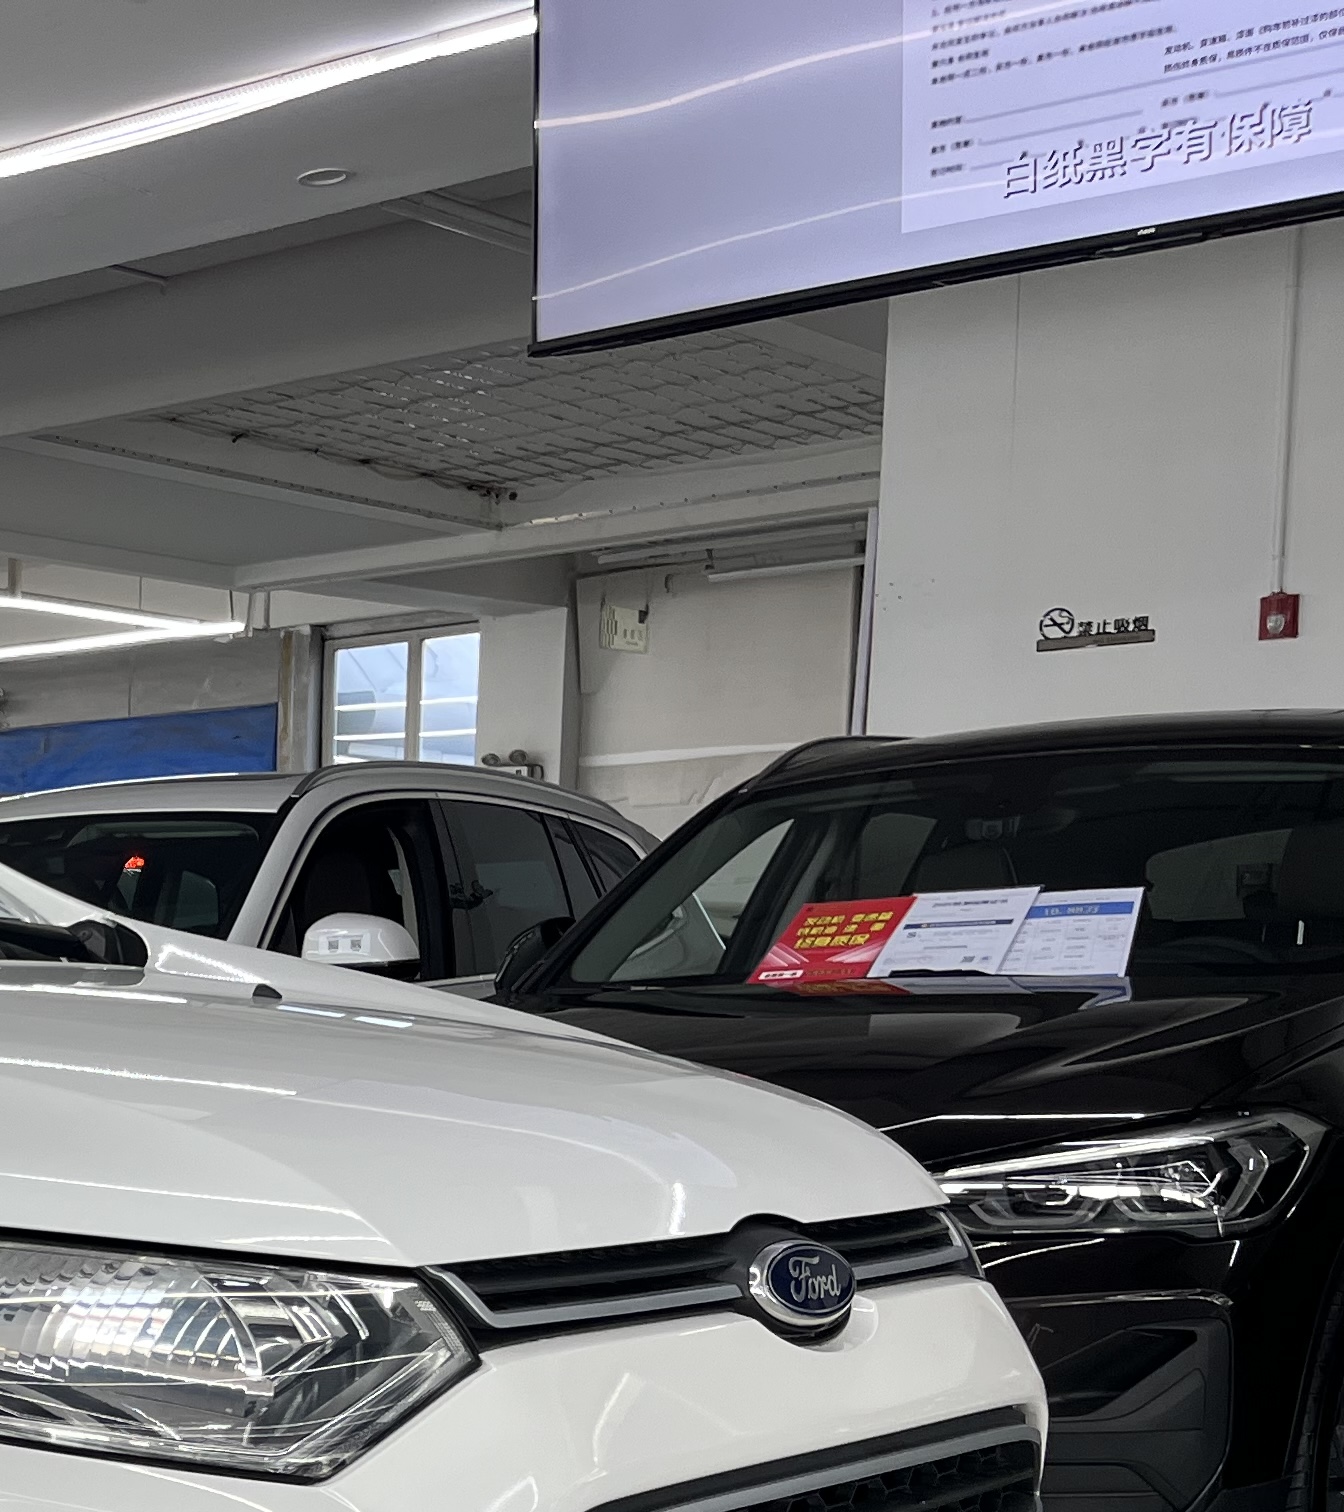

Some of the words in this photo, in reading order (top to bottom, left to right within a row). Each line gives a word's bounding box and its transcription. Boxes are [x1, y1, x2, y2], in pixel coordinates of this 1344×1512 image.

[1003, 98, 1313, 199] 白纸黑字有保障
[1078, 616, 1149, 637] 禁止吸烟
[789, 1256, 841, 1303] Ford
